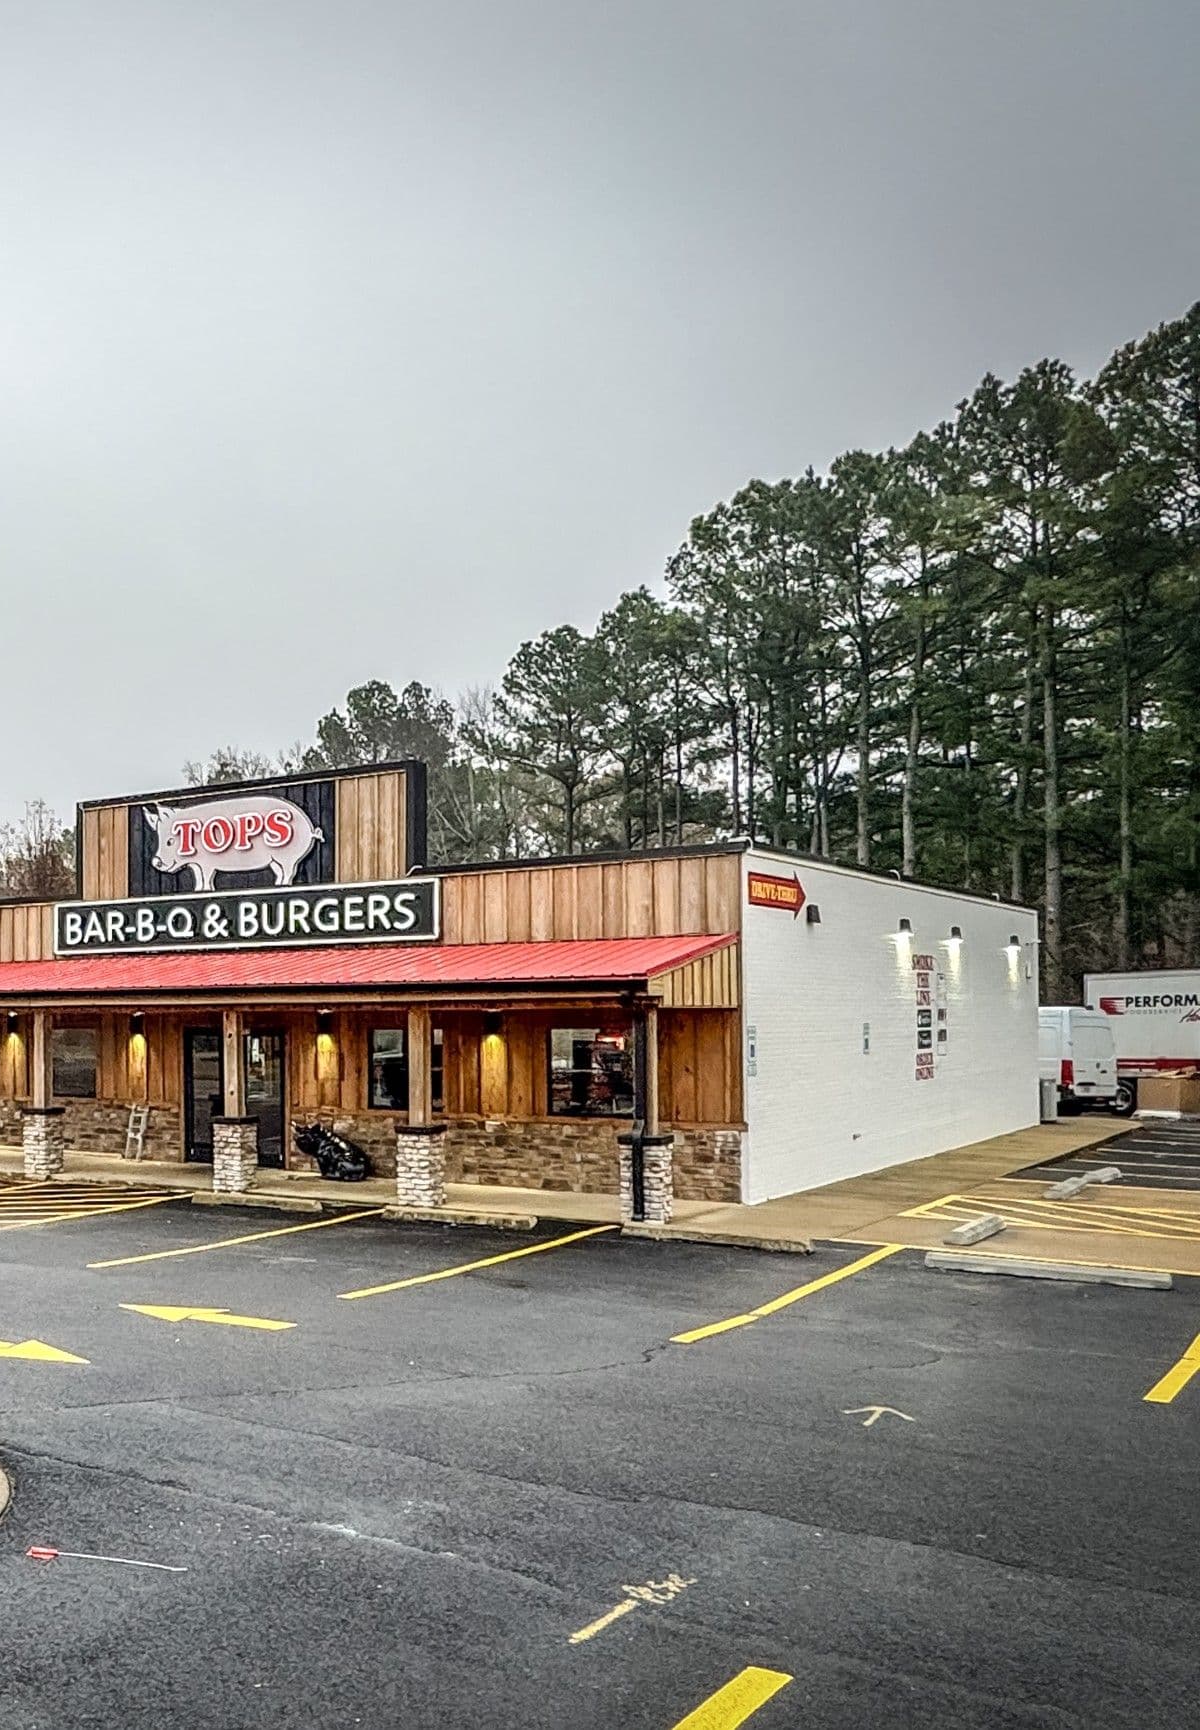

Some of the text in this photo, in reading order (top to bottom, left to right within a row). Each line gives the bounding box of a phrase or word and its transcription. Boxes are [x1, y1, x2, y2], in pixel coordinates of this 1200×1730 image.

[172, 808, 294, 856] TOPS
[65, 893, 416, 945] BAR-B-Q & BURGERS
[1126, 994, 1200, 1008] PERFORM
